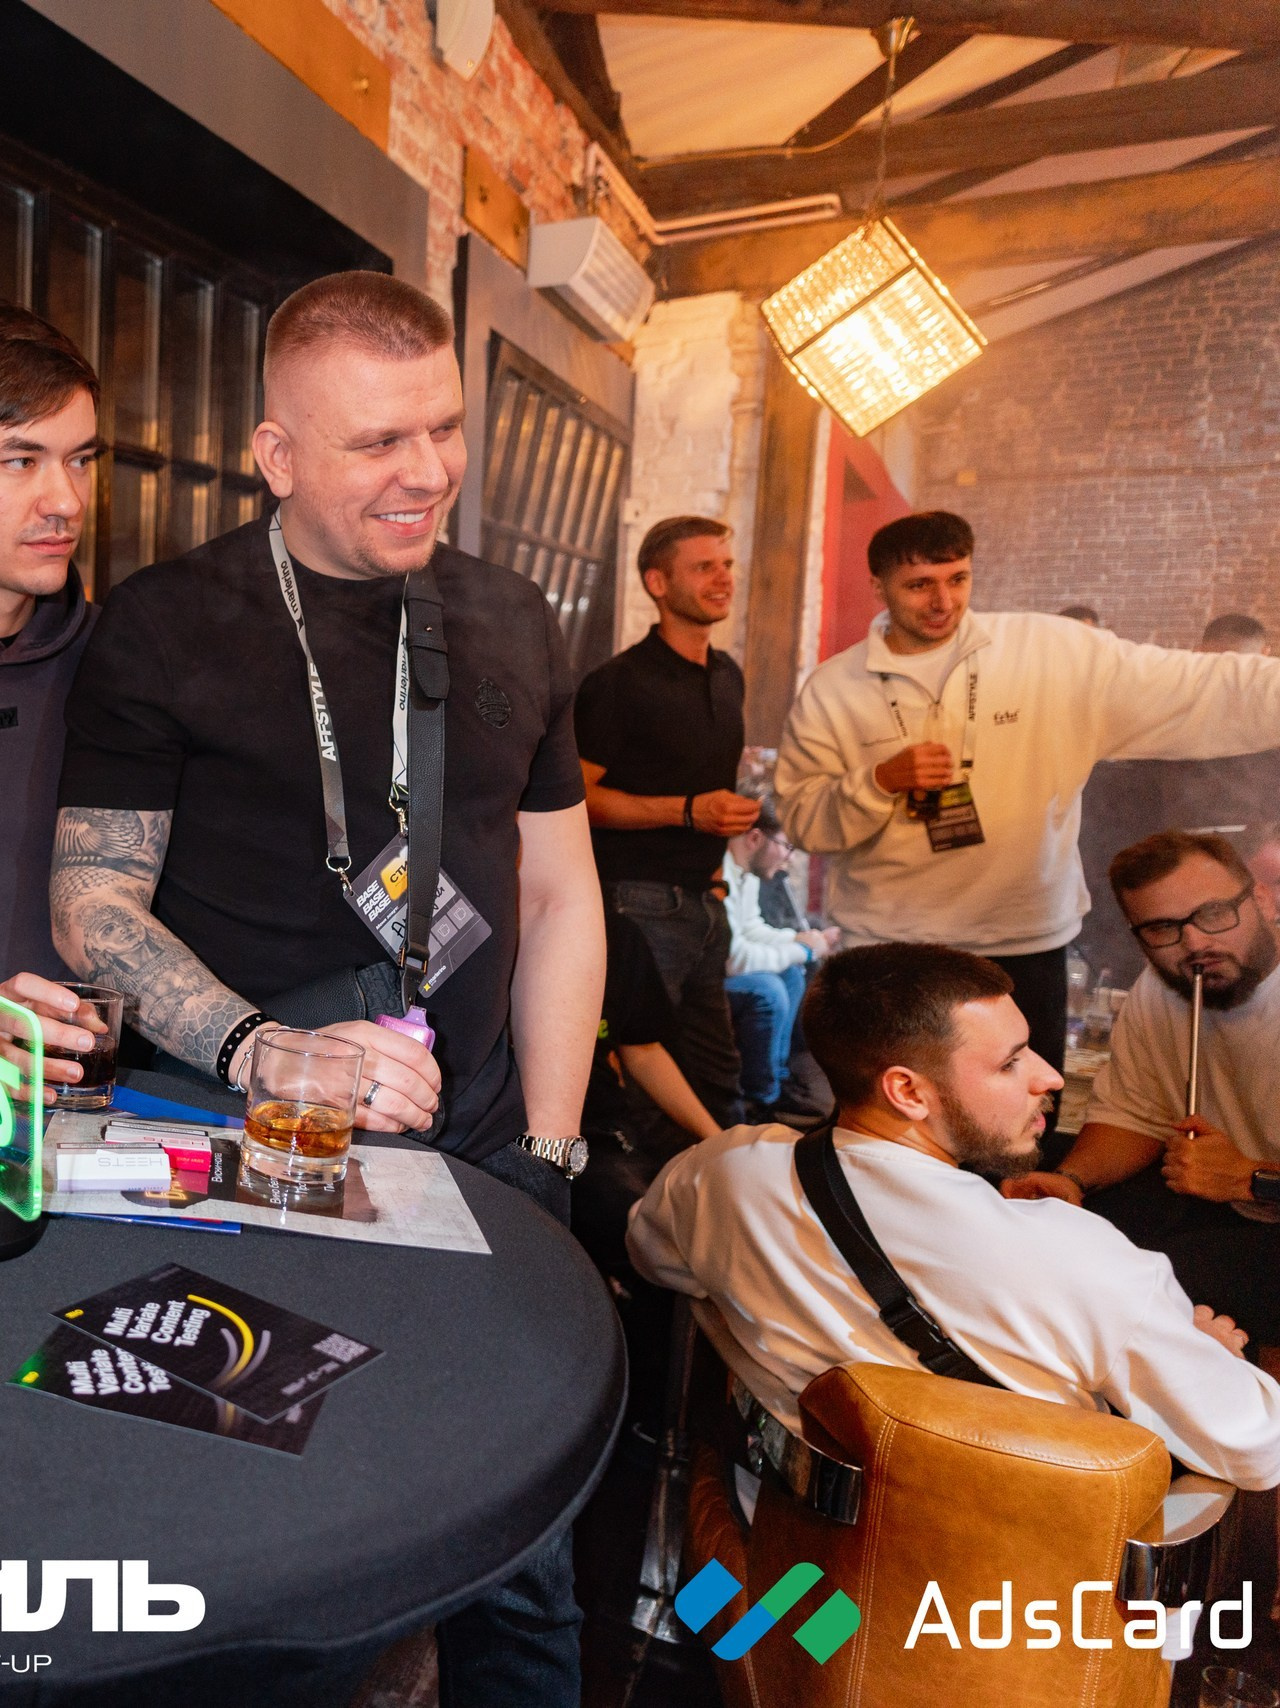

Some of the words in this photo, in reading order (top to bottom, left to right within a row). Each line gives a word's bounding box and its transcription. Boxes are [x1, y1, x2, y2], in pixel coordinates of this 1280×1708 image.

[280, 560, 299, 614] marlerino
[310, 663, 337, 761] AFFSTYLE
[356, 880, 380, 908] BASE
[362, 888, 386, 915] BASE
[368, 895, 392, 922] BASE
[98, 1157, 163, 1167] HEETS
[270, 1189, 282, 1204] Вино
[103, 1307, 134, 1336] Multi
[126, 1302, 161, 1339] Variate
[150, 1300, 187, 1344] Content
[174, 1308, 211, 1347] Testing
[66, 1360, 96, 1395] Multi
[91, 1348, 120, 1396] Variate
